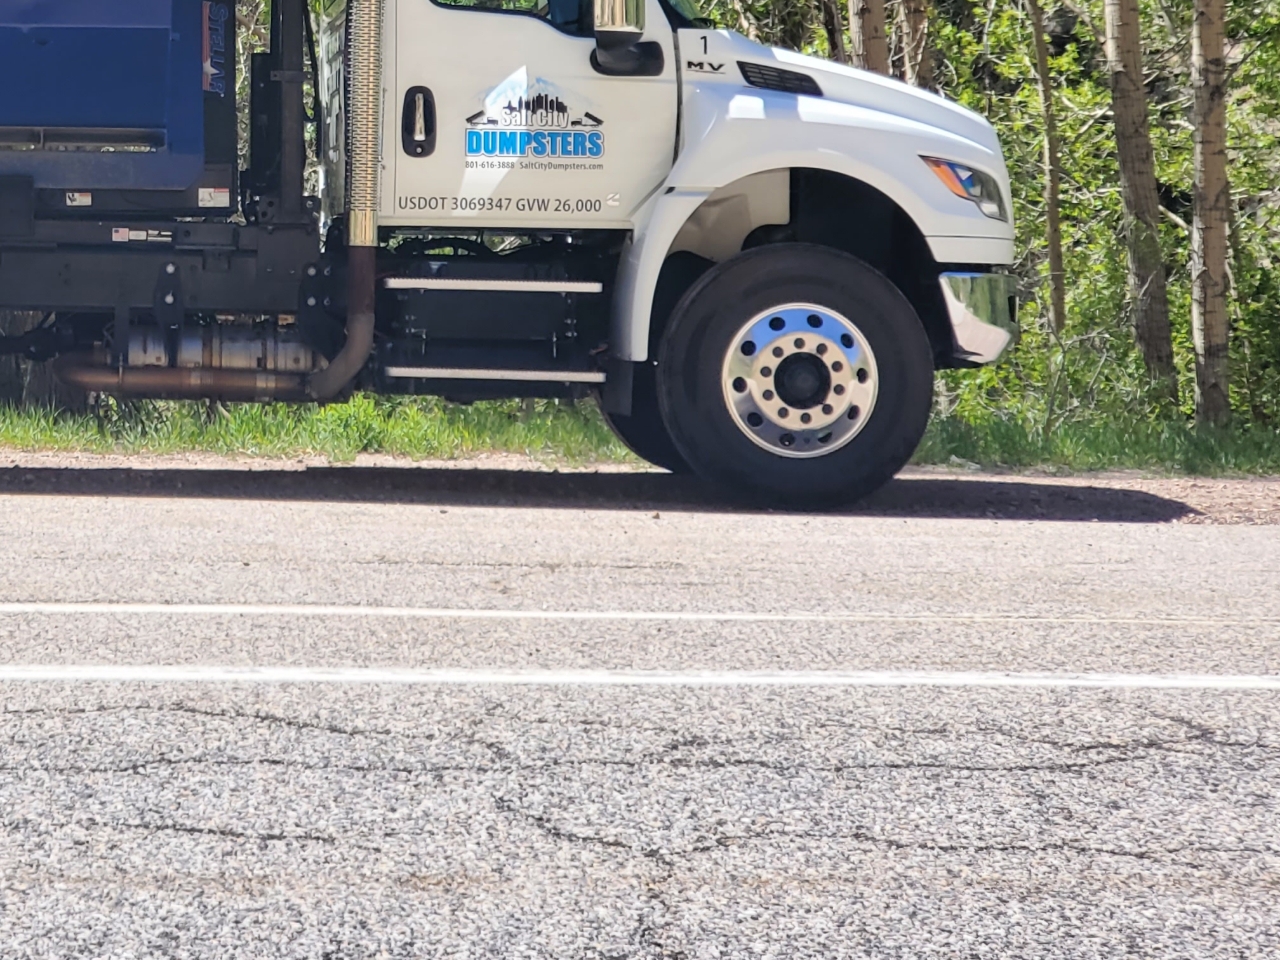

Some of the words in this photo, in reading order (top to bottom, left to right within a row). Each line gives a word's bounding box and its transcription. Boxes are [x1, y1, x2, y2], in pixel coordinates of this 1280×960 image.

[700, 35, 708, 55] 1
[686, 61, 726, 72] MV
[501, 108, 534, 127] Salt
[539, 108, 569, 128] City
[465, 128, 605, 159] DUMPSTERS
[465, 160, 515, 170] 801-616-3888
[519, 161, 604, 172] SaltCityDumpsters.com
[398, 196, 448, 210] USDOT
[451, 197, 512, 211] 3069347
[515, 197, 551, 212] GVW
[553, 198, 602, 214] 26,000
